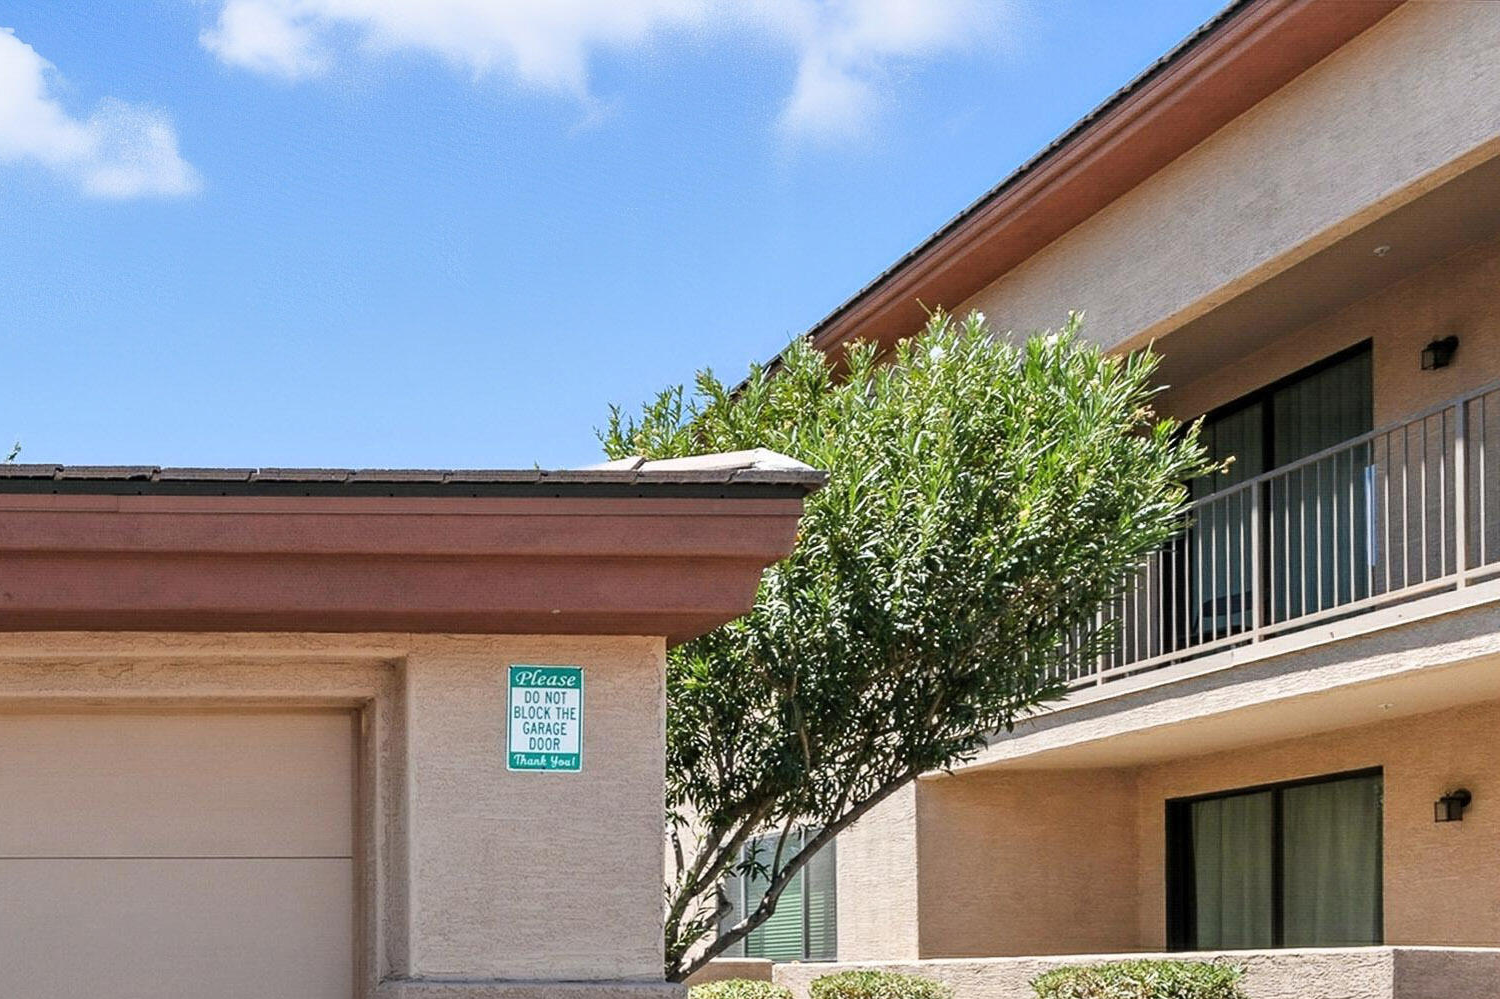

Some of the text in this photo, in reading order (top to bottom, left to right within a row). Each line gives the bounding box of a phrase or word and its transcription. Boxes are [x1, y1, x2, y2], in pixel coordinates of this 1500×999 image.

[515, 669, 576, 686] Please
[524, 690, 567, 705] DO NOT
[514, 706, 576, 720] BLOCK THE
[522, 721, 567, 735] GARAGE
[529, 737, 561, 751] DOOR
[513, 753, 575, 768] Thank You!
